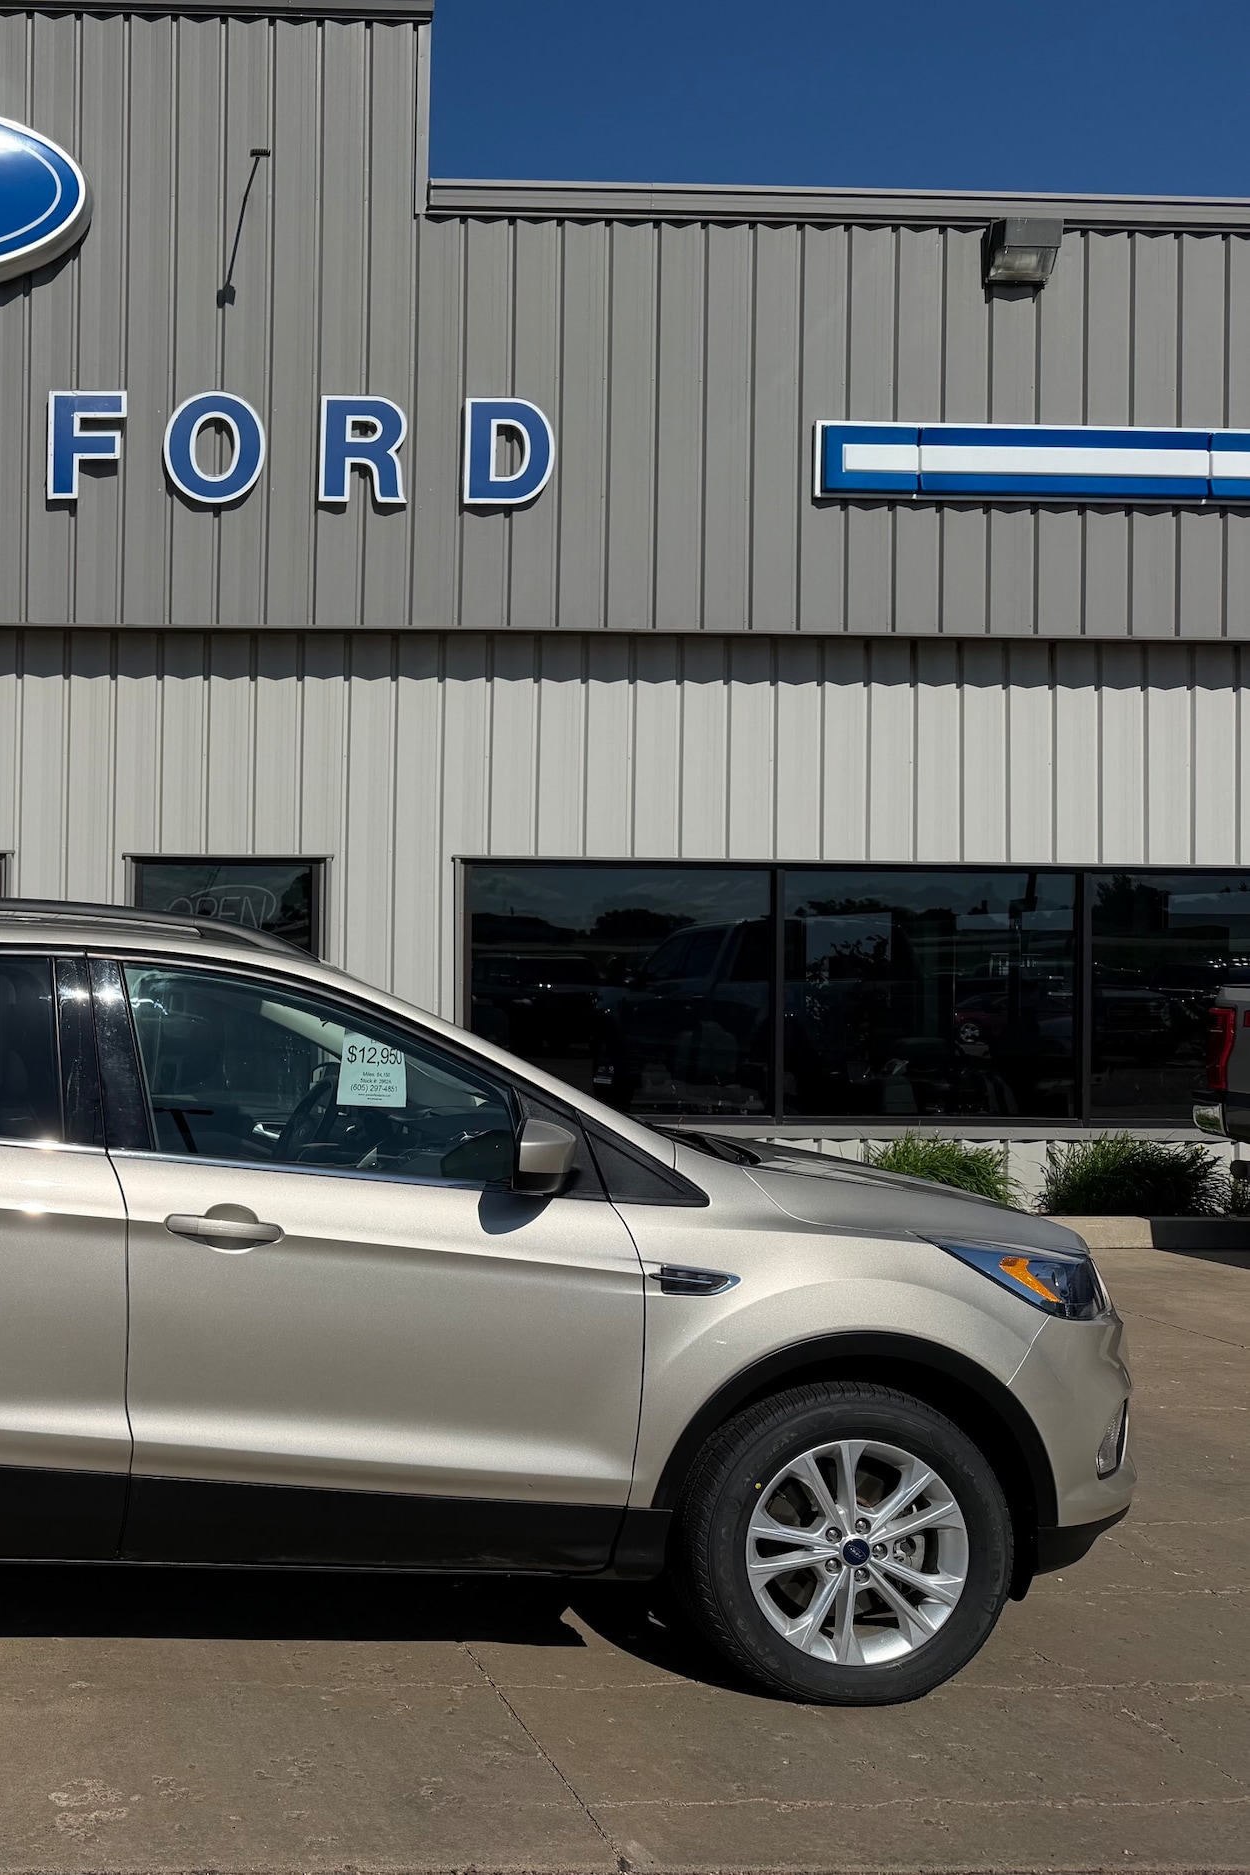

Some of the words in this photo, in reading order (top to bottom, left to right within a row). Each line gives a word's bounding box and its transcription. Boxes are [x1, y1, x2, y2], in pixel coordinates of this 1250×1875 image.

[47, 390, 554, 505] FORD
[347, 1045, 403, 1067] $12,950
[350, 1083, 369, 1093] (605)
